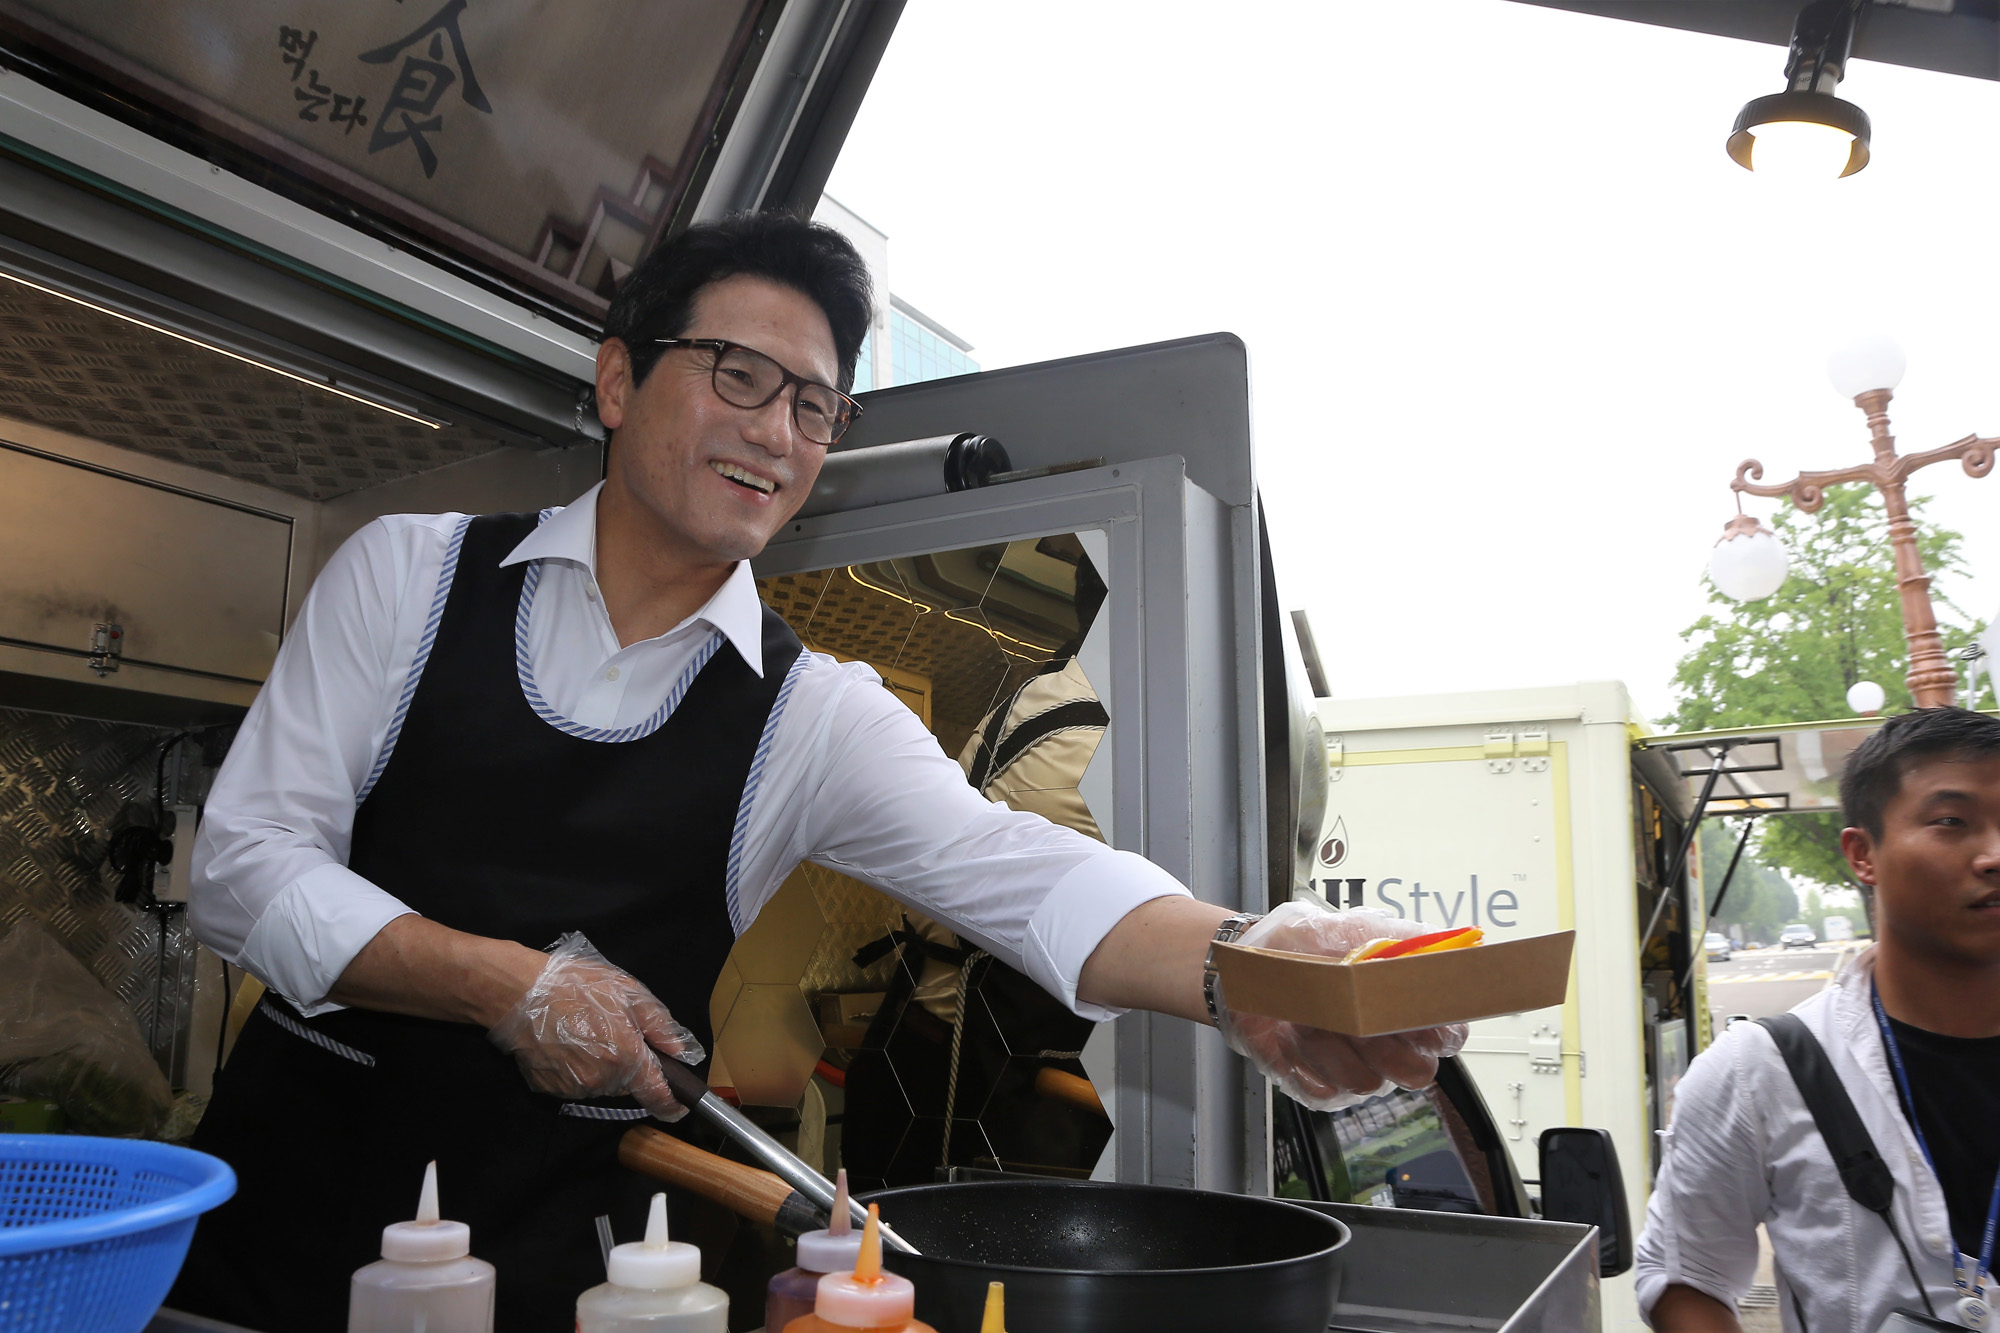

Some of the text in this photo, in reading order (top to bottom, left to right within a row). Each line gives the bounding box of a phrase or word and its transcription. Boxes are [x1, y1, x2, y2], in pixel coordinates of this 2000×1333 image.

[279, 25, 367, 134] 먹는다
[358, 0, 493, 179] 食
[1377, 874, 1519, 929] Style
